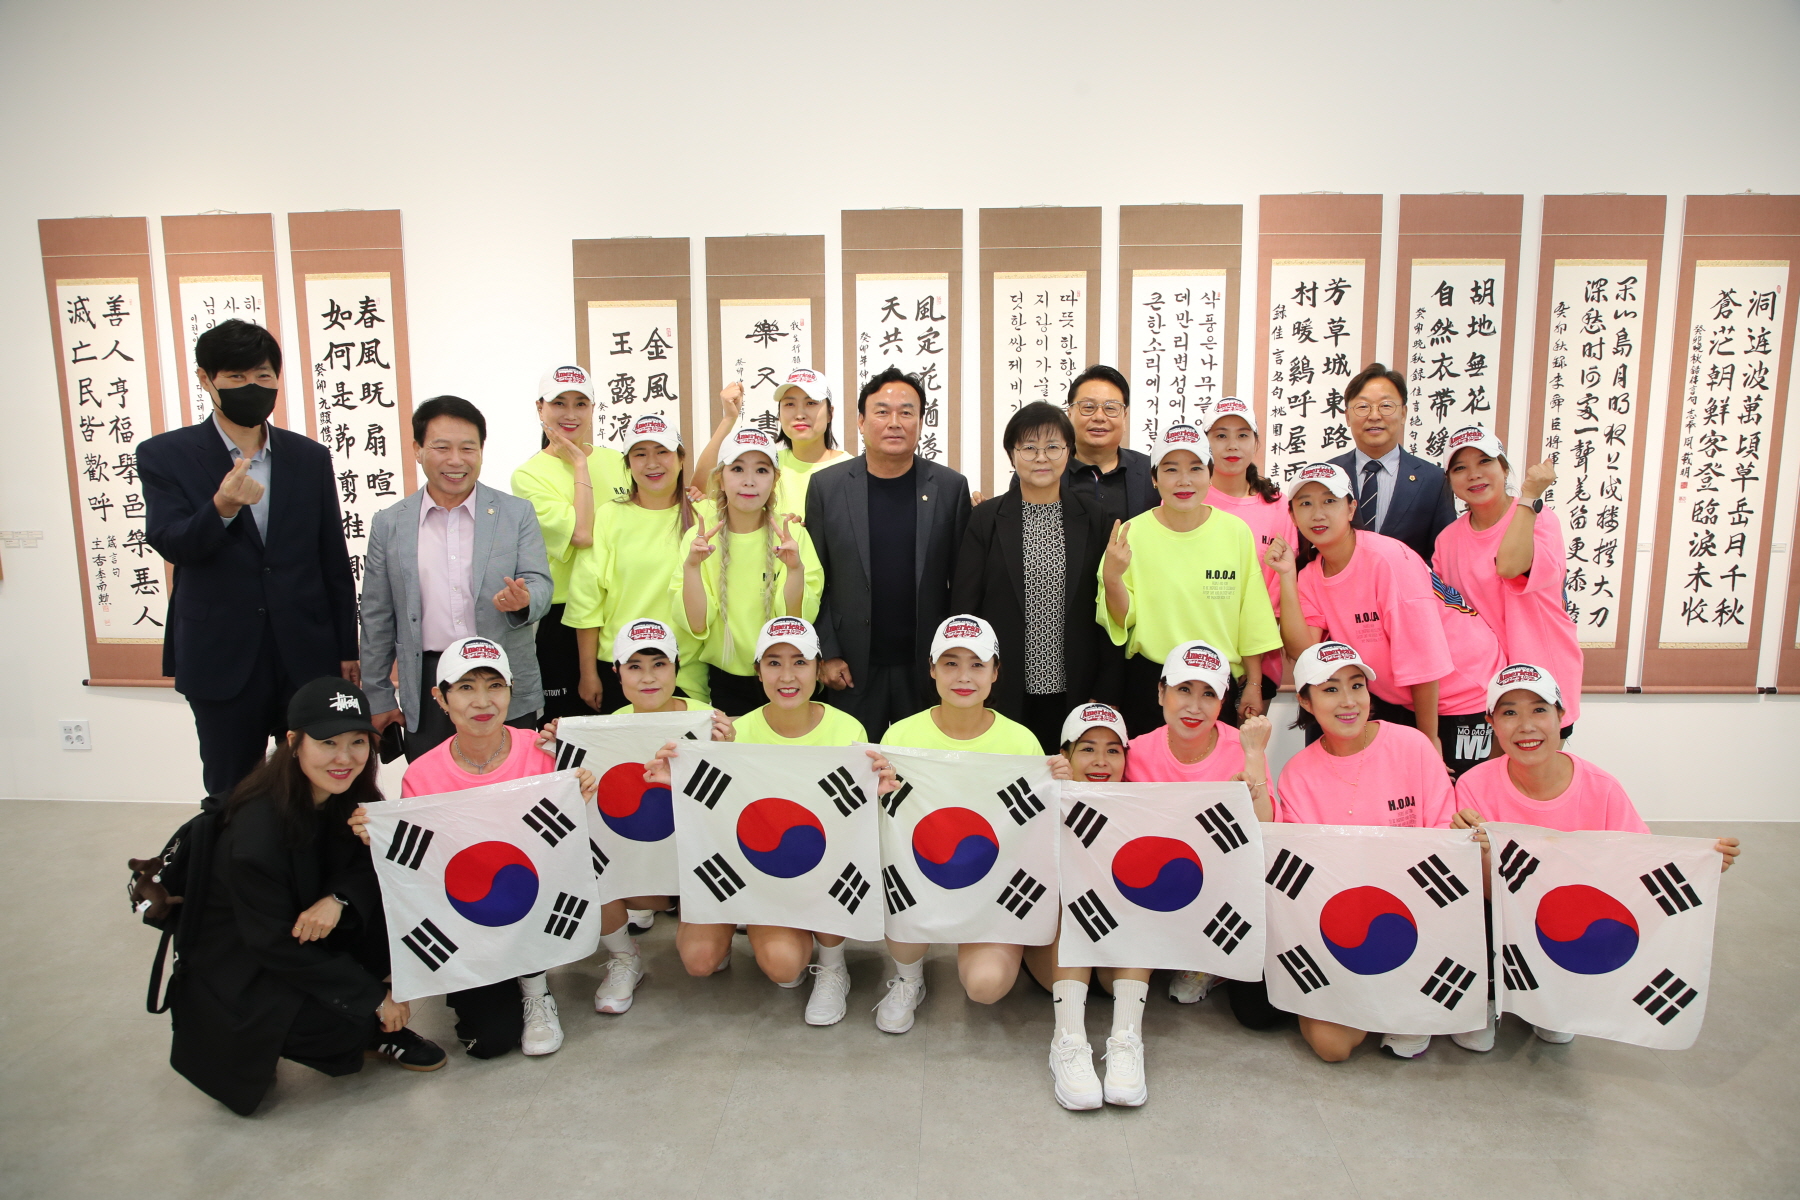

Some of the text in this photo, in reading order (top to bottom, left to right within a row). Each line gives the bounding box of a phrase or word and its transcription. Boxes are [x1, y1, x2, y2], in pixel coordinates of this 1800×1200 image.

[879, 296, 907, 364] 天共
[1461, 278, 1496, 424] 胡地無花
[640, 327, 678, 413] 金風
[597, 401, 608, 446] 癸卯年
[635, 421, 666, 430] American
[737, 433, 768, 442] American
[1166, 430, 1199, 439] American
[1450, 430, 1482, 443] American
[1302, 467, 1335, 475] American
[1205, 570, 1236, 580] H.O.O.A
[631, 627, 665, 635] American
[770, 622, 804, 632] American
[946, 624, 981, 633] American
[463, 645, 499, 655] American
[1320, 649, 1355, 658] American
[1185, 651, 1220, 666] American
[1500, 670, 1539, 681] American
[1083, 709, 1117, 718] American
